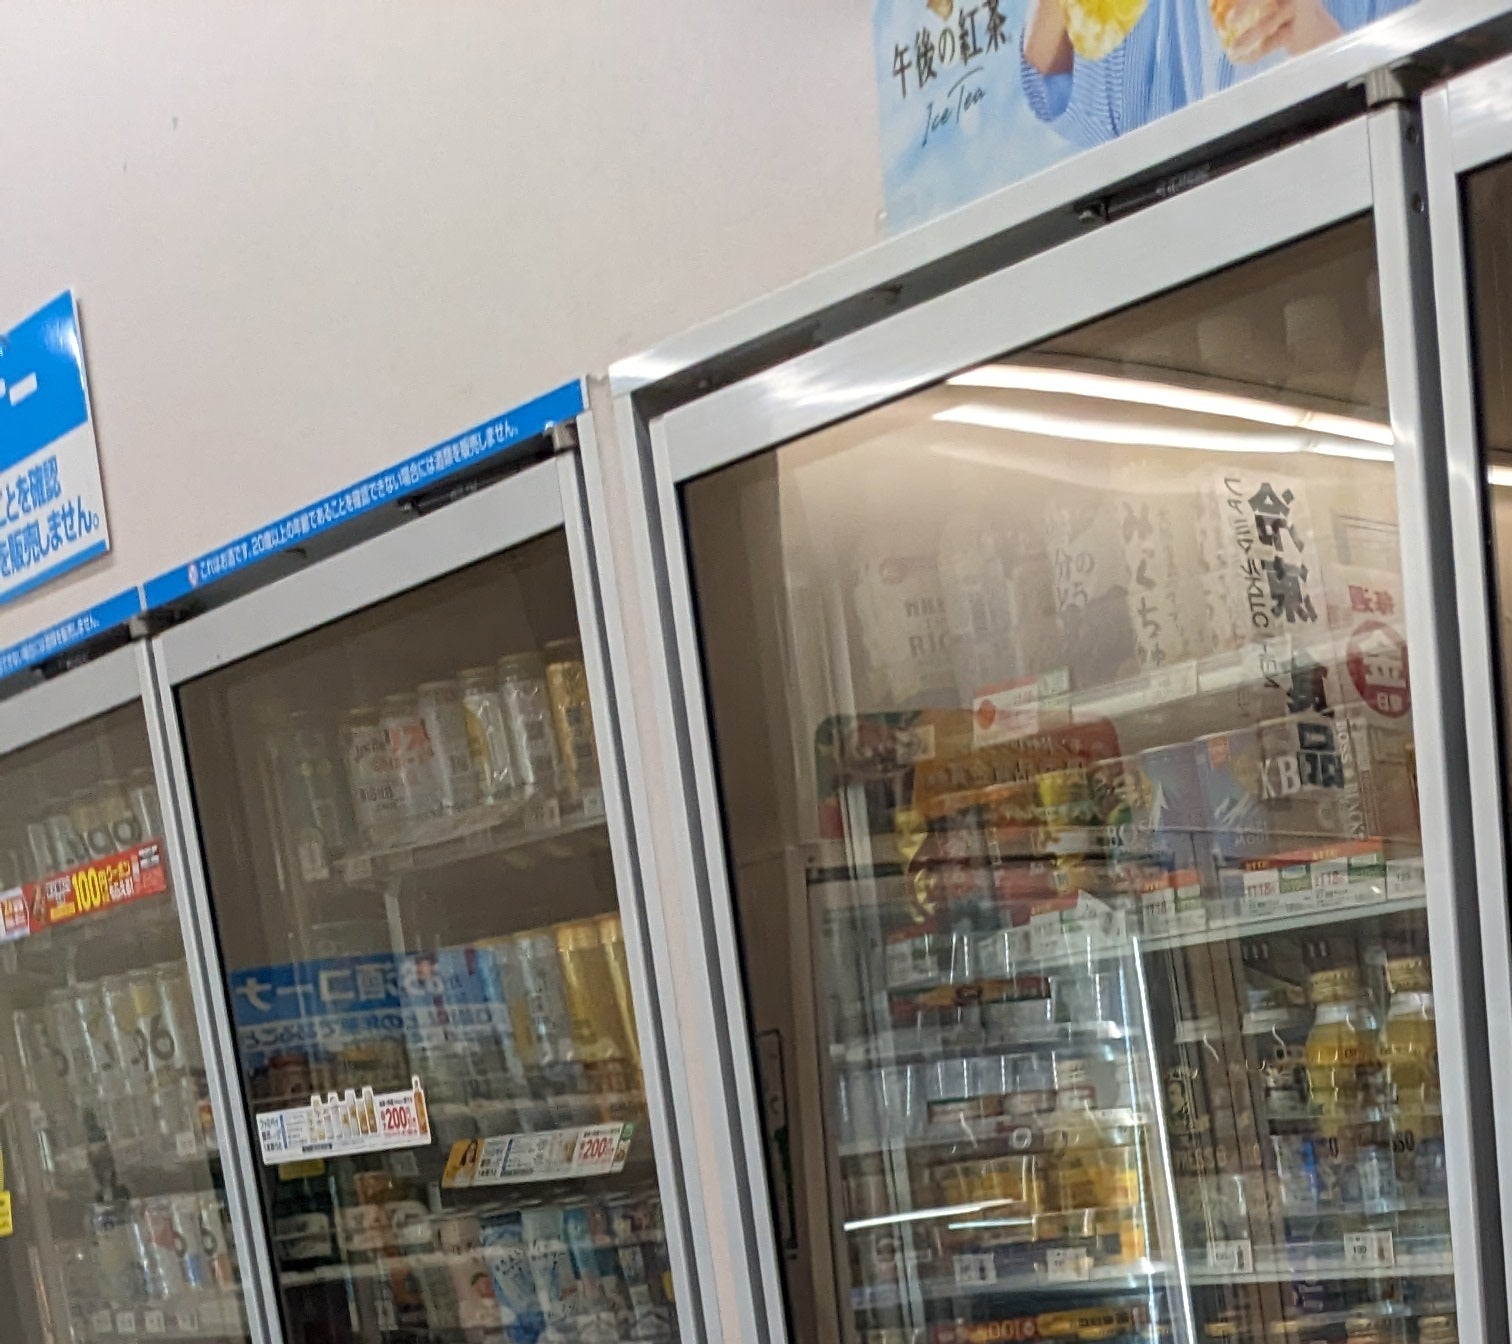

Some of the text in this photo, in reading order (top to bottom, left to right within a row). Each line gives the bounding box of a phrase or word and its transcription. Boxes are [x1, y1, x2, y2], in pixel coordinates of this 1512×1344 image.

[893, 0, 1007, 99] 午後の紅茶
[947, 66, 985, 124] Tea
